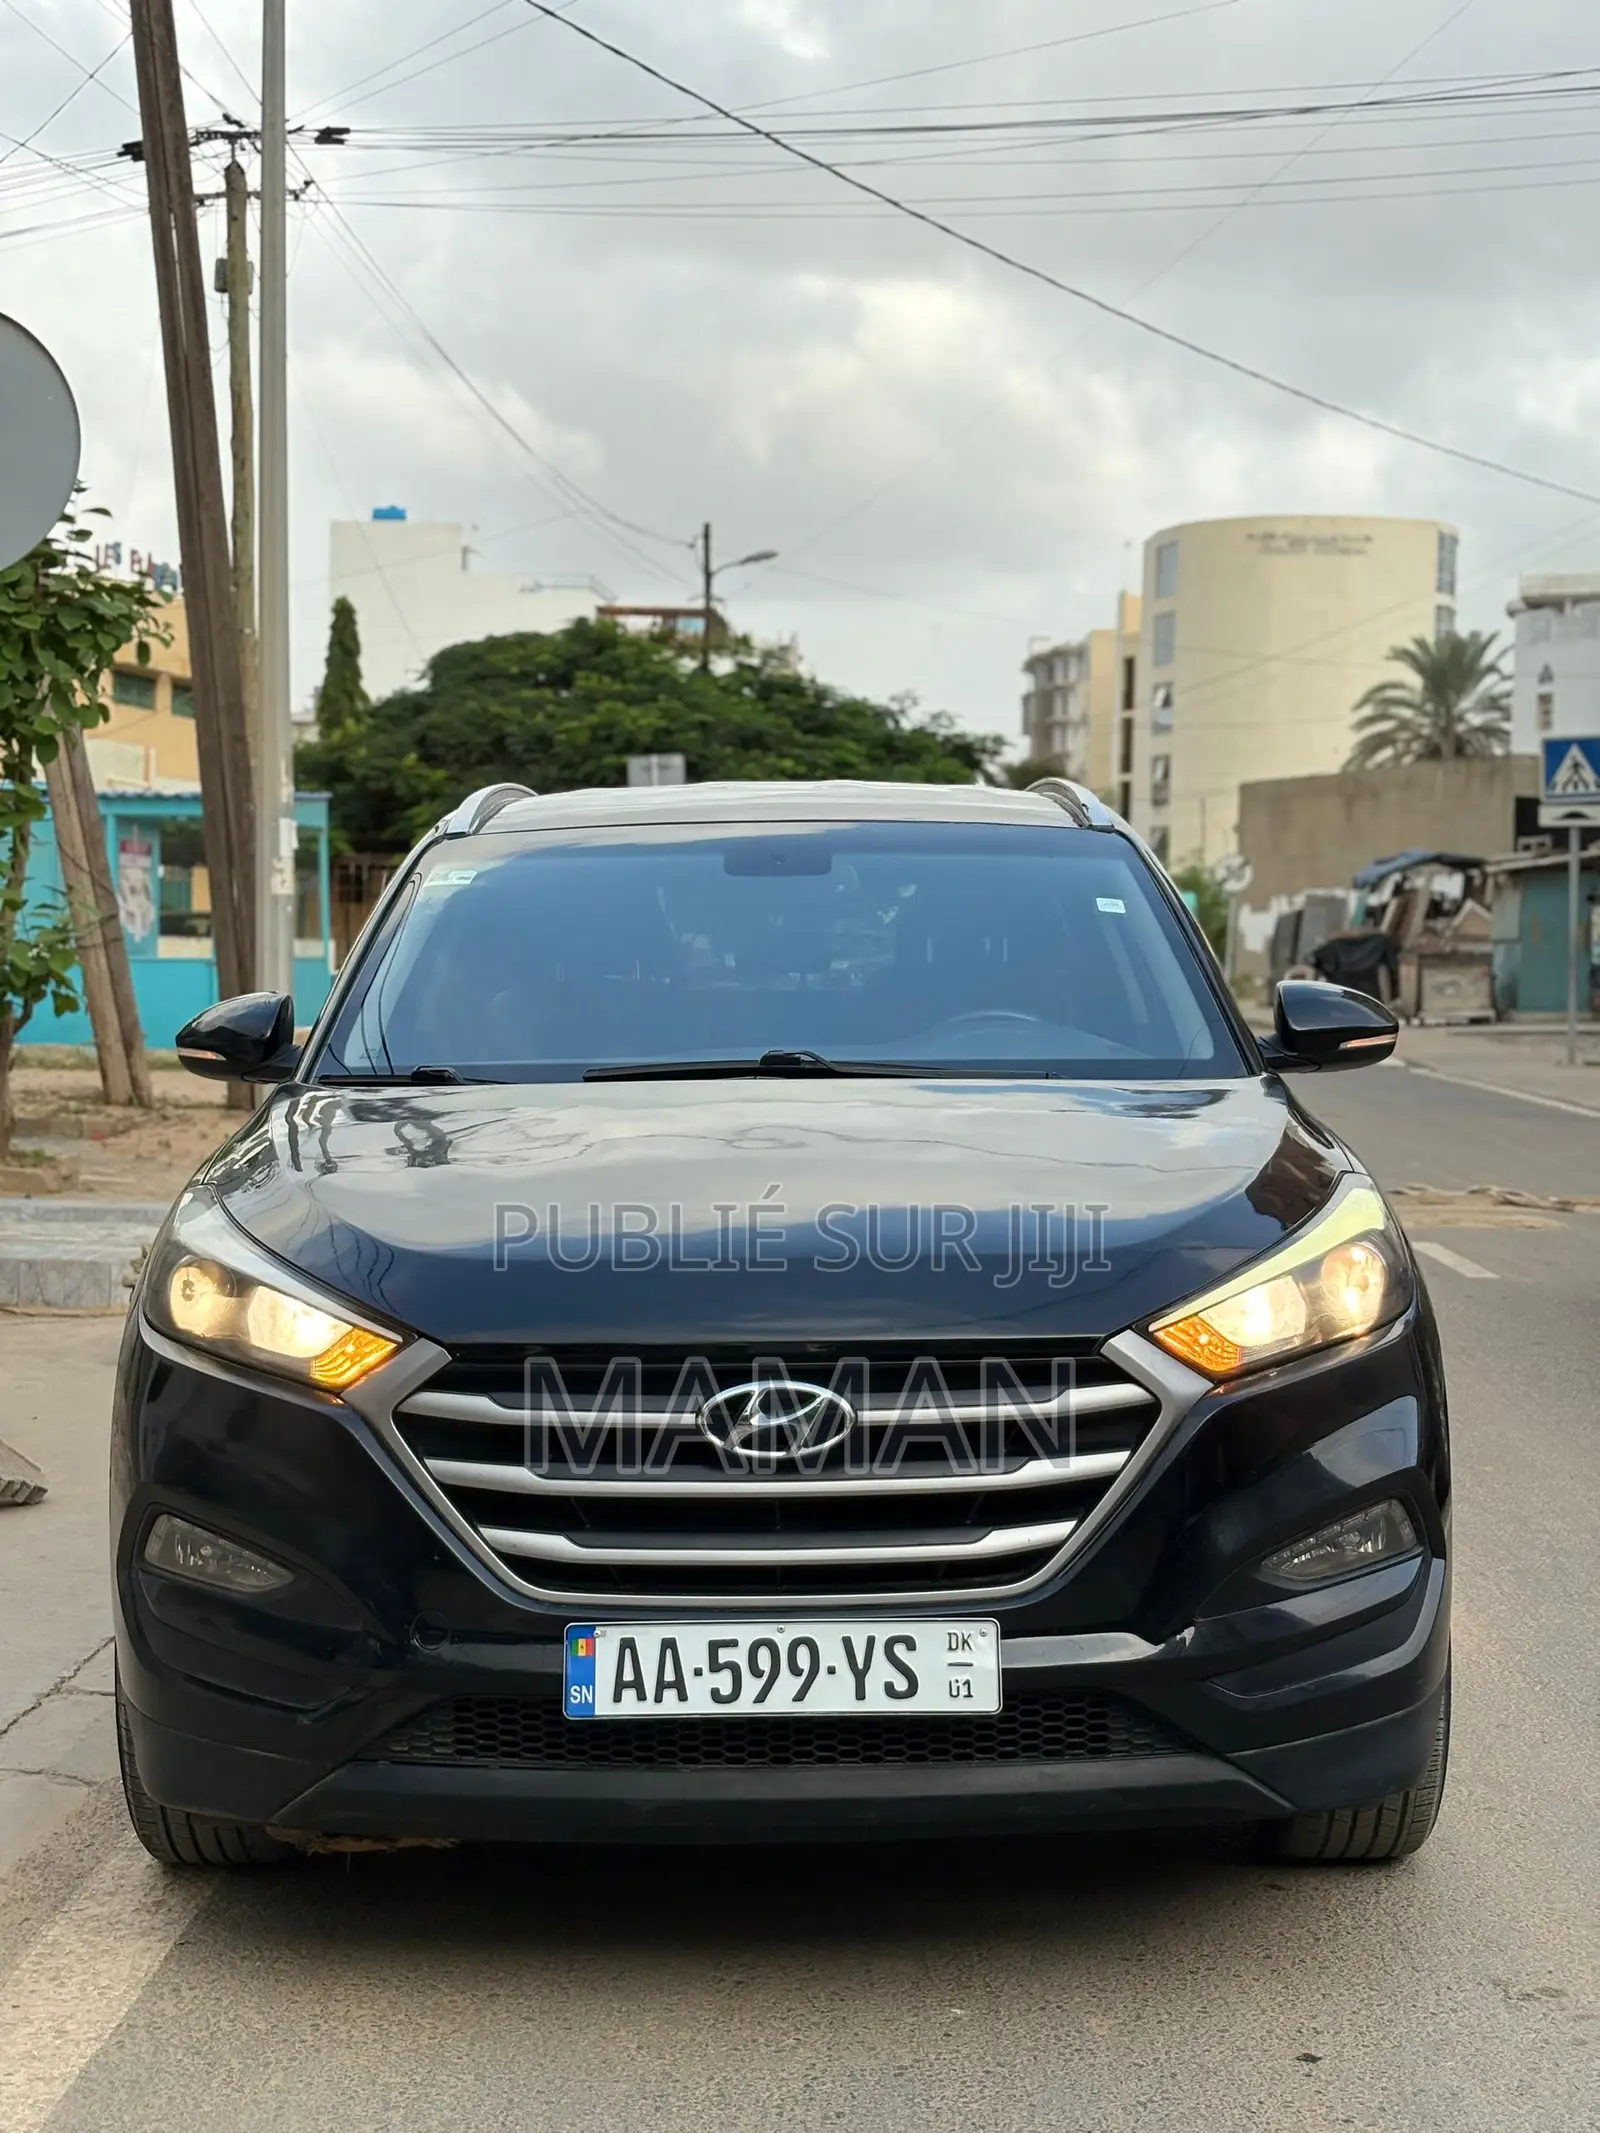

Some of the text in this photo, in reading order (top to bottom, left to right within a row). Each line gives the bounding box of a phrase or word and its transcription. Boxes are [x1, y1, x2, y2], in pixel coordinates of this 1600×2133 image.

[947, 1631, 973, 1651] DK
[613, 1634, 919, 1704] AA-599-YS
[570, 1685, 593, 1704] SN
